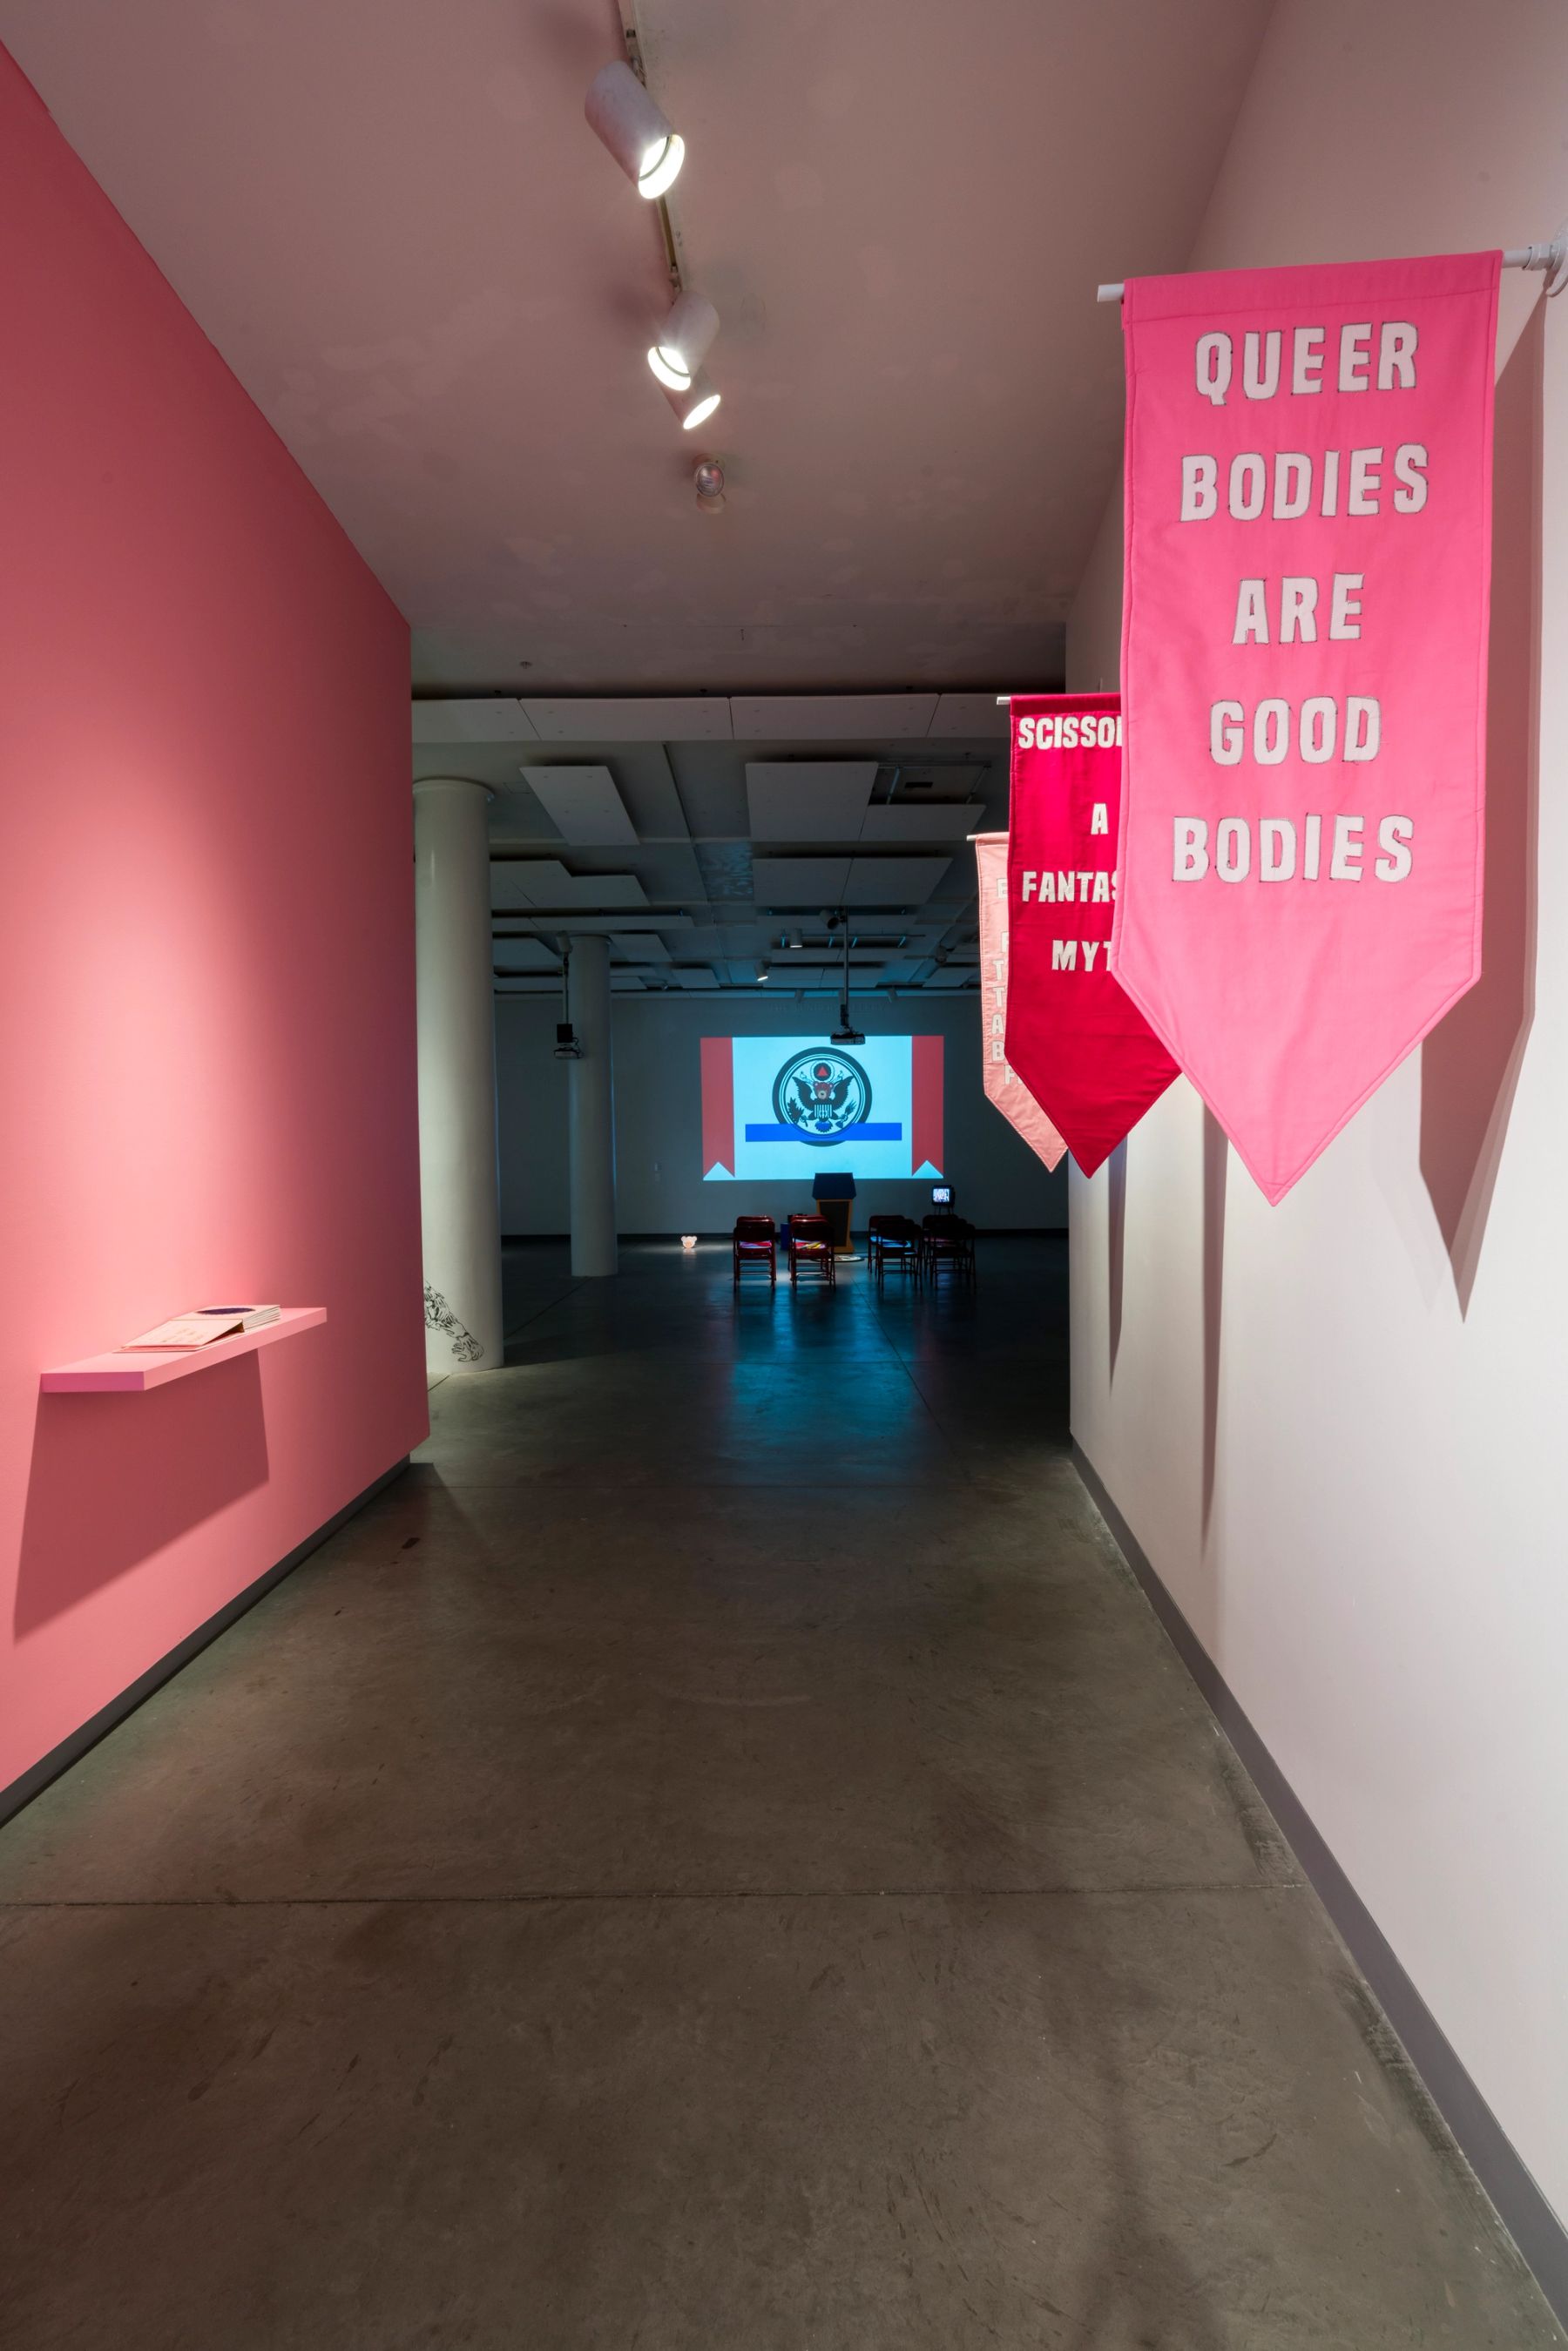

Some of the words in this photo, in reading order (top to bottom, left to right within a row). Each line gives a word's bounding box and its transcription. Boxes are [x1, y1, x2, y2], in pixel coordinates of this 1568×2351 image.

[1194, 321, 1419, 406] QUEER
[1179, 443, 1429, 523] BODIES
[1232, 572, 1365, 645] ARE
[1209, 696, 1382, 767] GOOD
[1092, 802, 1109, 835] A
[1172, 813, 1415, 884] BODIES
